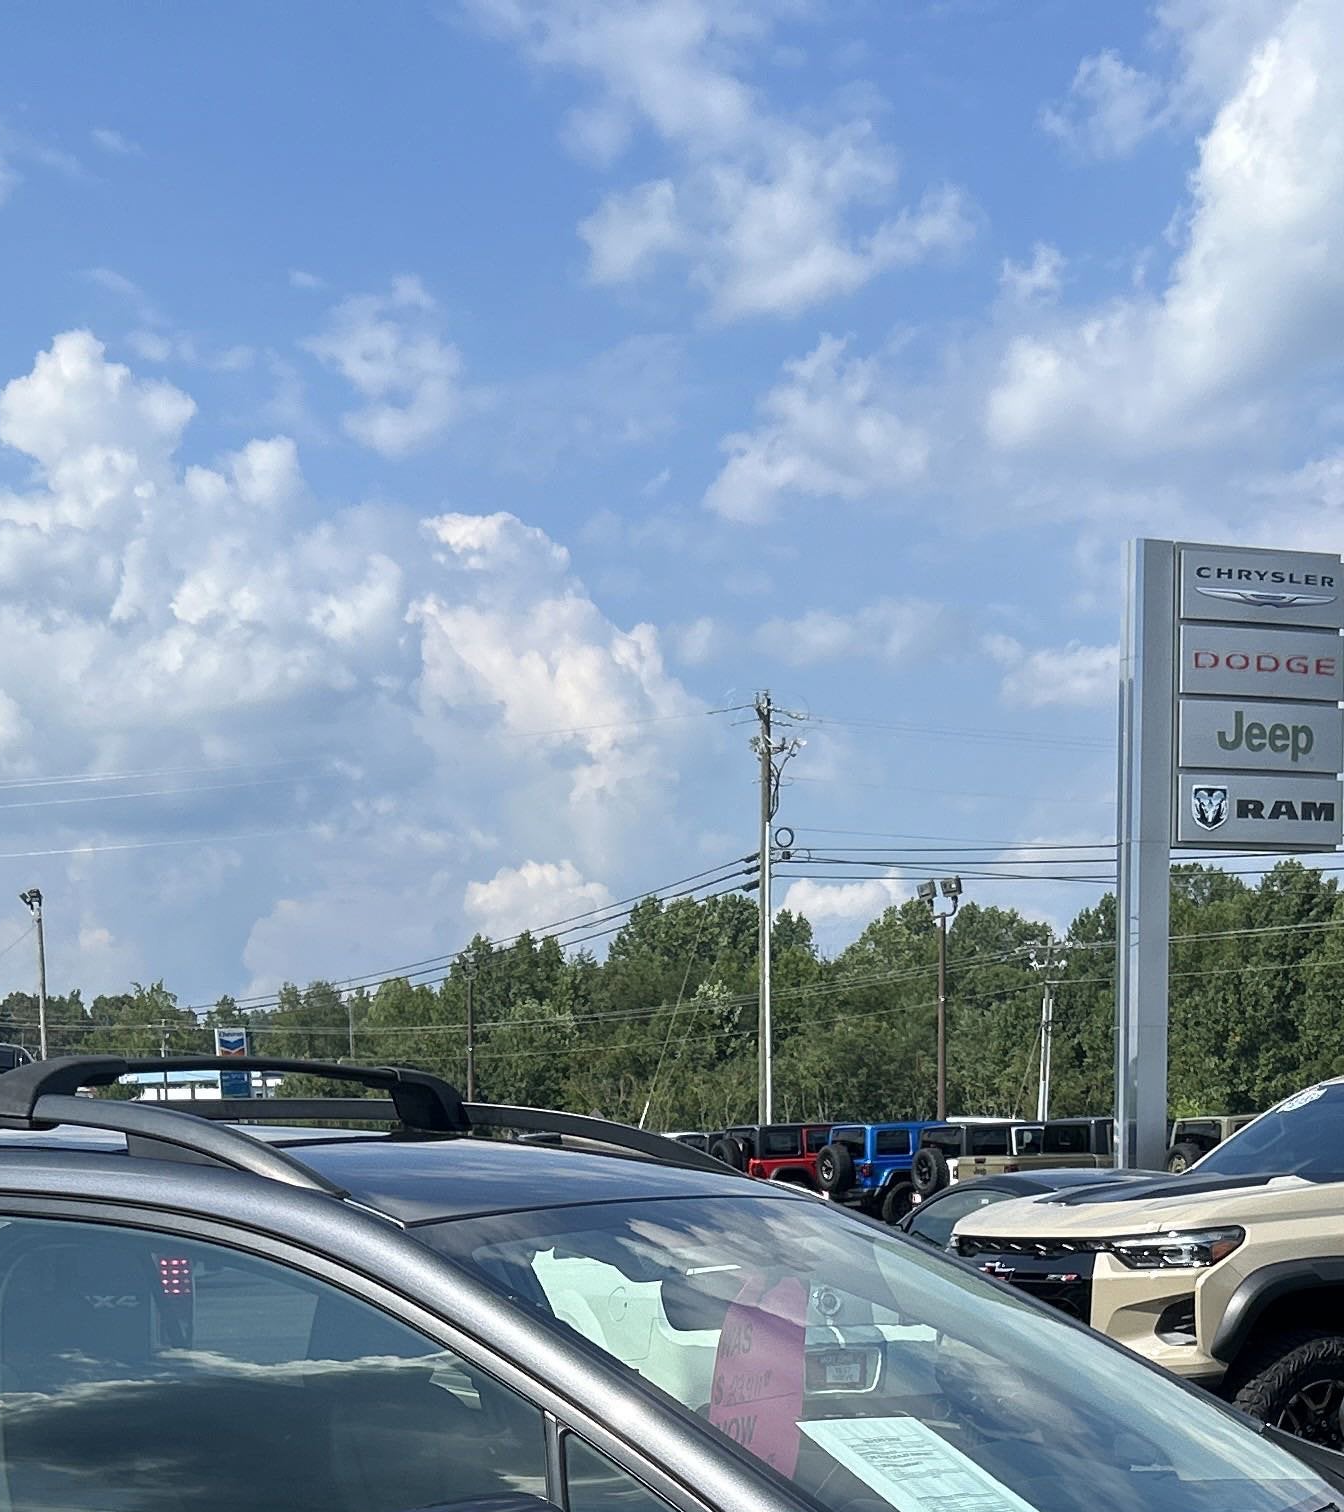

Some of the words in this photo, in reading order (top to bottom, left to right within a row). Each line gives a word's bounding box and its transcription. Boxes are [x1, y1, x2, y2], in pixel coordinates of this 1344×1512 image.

[1195, 566, 1335, 588] CHRYSLER
[1193, 651, 1337, 677] DODGE
[1216, 710, 1315, 763] Jeep
[1236, 799, 1335, 822] RAM
